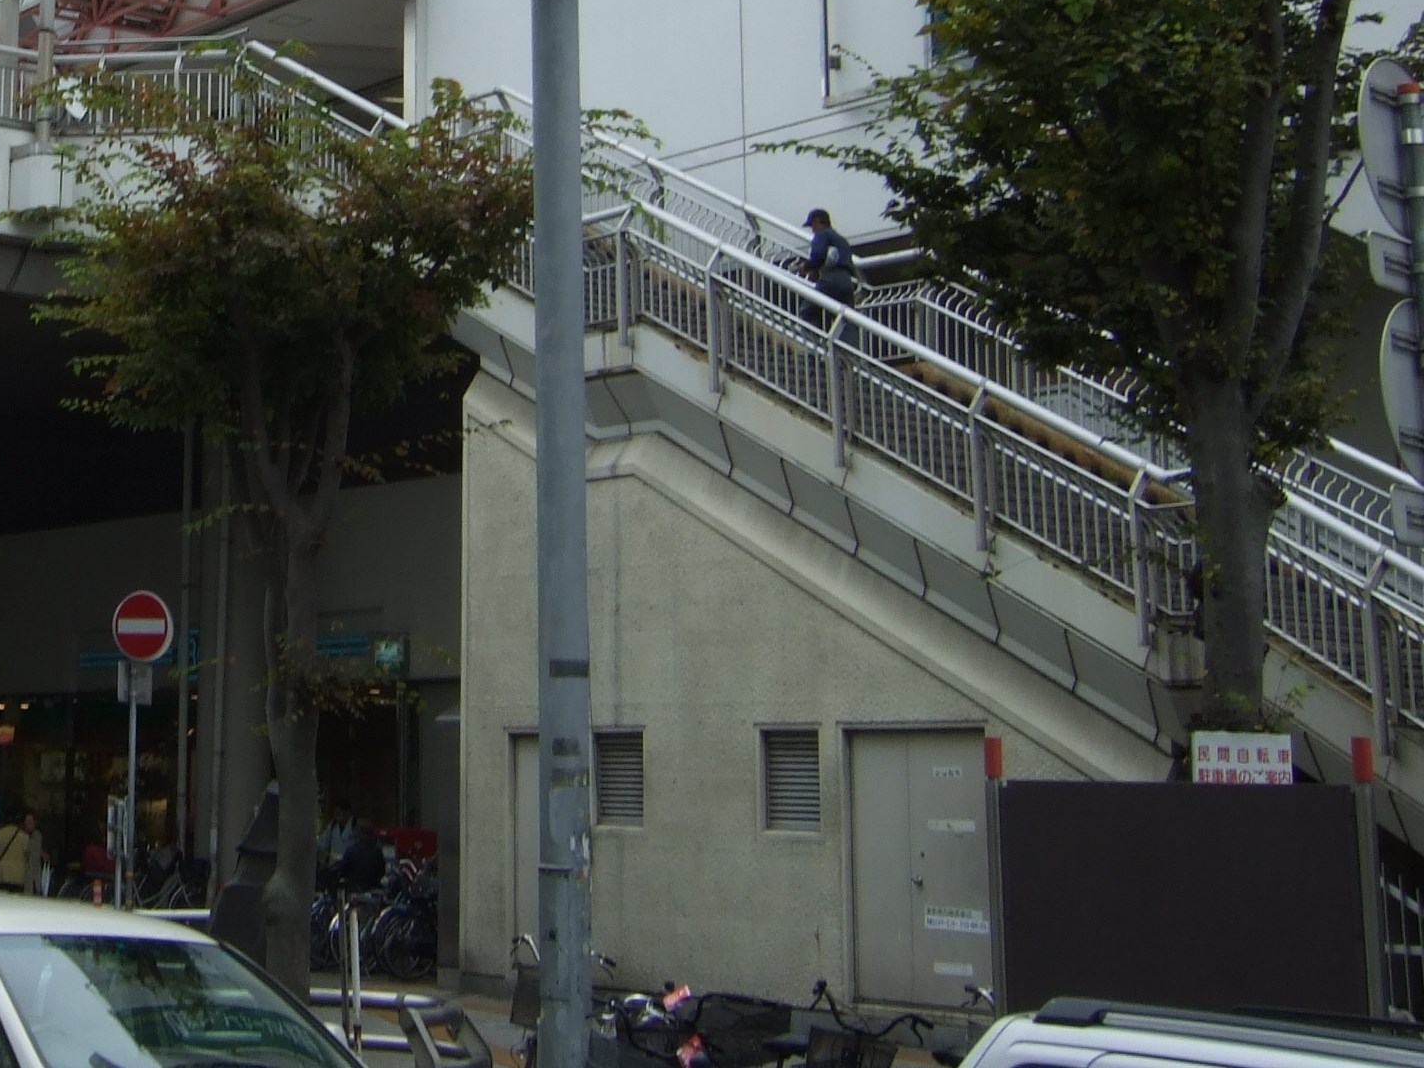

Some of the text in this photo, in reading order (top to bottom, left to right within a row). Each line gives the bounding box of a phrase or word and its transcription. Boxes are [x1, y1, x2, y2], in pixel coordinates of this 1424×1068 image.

[1198, 745, 1290, 764] 民間自転車
